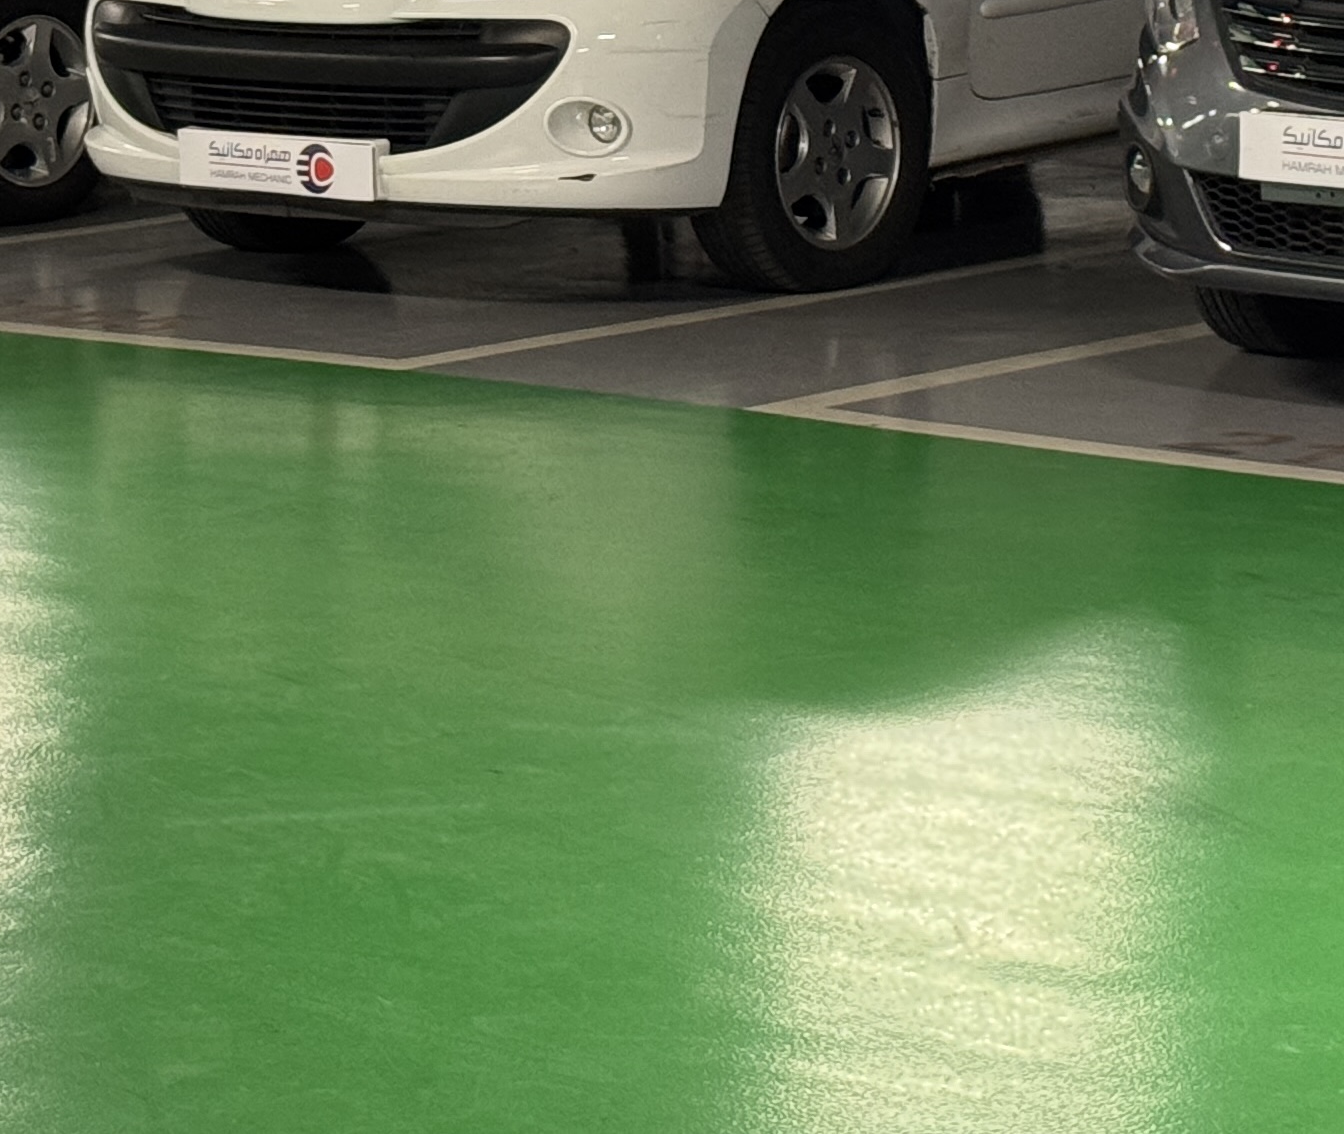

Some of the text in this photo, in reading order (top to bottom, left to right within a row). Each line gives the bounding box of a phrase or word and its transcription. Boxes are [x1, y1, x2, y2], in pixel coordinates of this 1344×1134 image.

[1282, 126, 1343, 150] مکانیک
[208, 140, 291, 164] همراه مکانیک
[1282, 160, 1332, 175] HAMRAH
